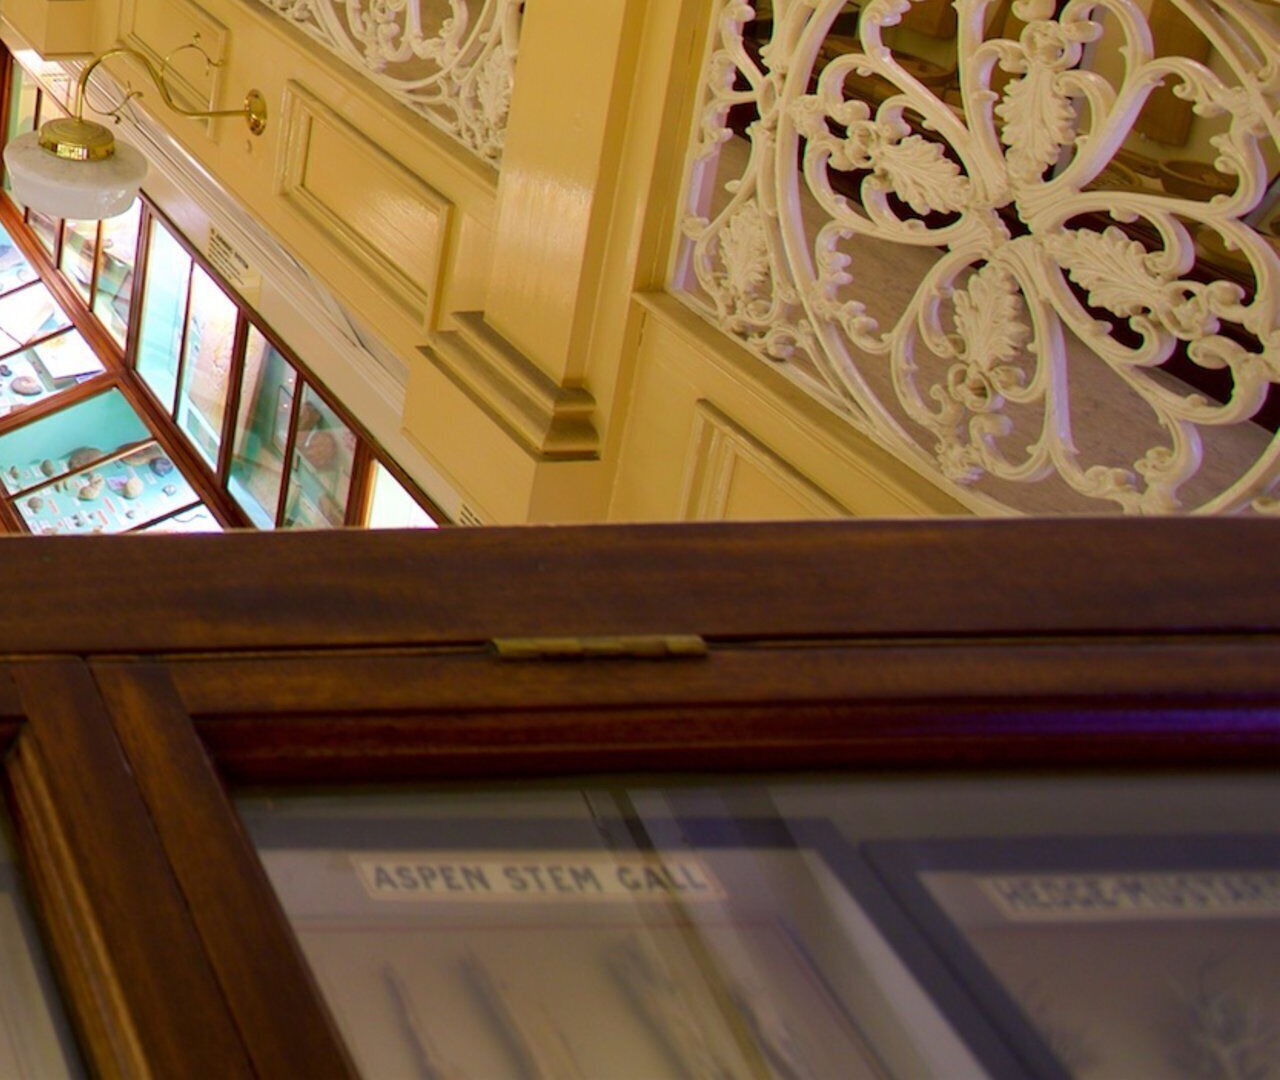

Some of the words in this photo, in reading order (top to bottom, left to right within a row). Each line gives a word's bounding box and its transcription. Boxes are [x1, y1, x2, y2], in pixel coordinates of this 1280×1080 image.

[374, 866, 490, 891] ASPEN
[502, 866, 603, 893] STEM
[615, 865, 708, 891] GALL
